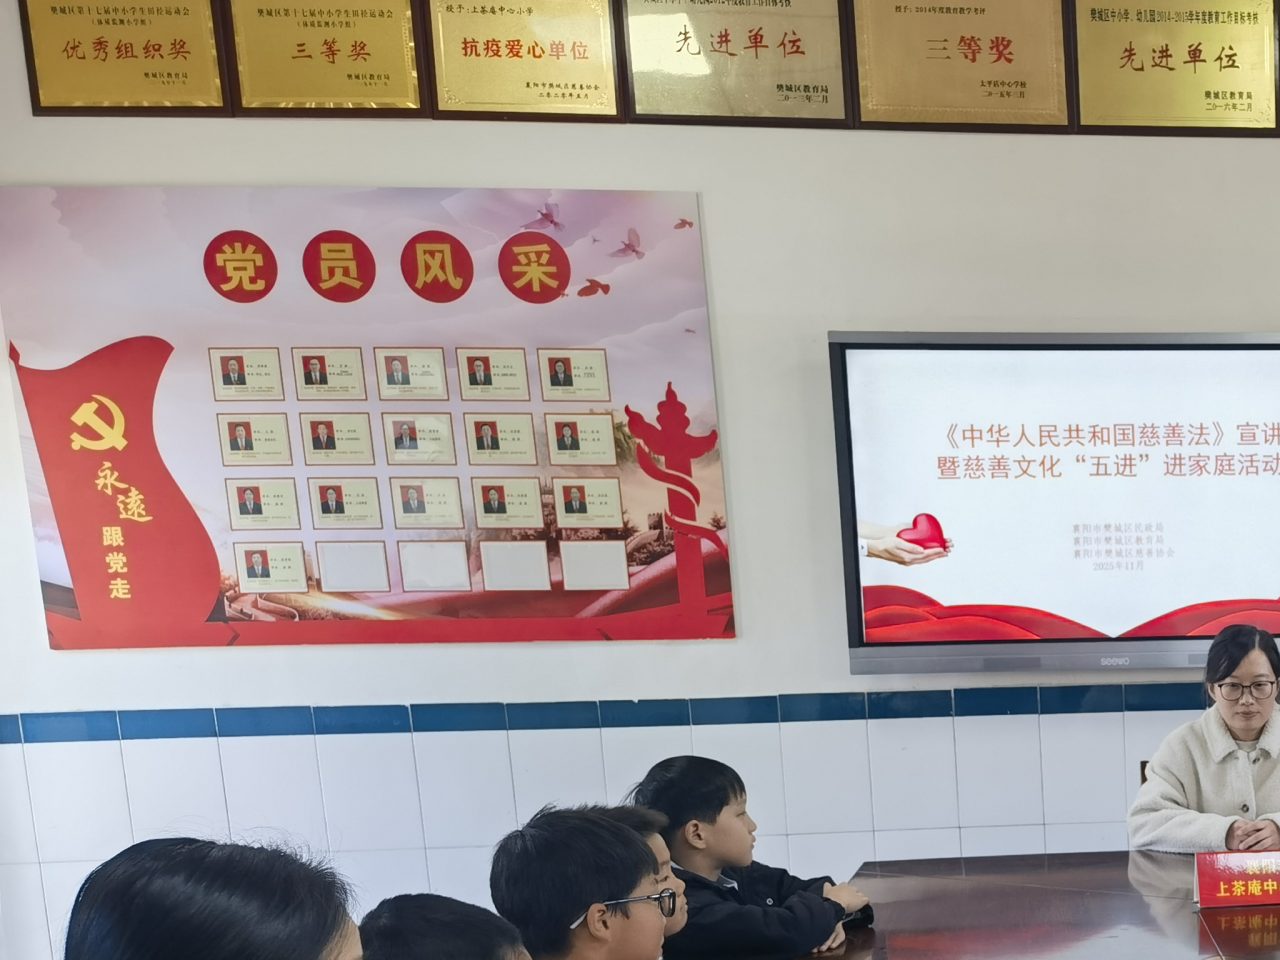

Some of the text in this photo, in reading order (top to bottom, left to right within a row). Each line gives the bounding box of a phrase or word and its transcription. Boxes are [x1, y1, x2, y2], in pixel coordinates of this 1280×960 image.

[62, 36, 191, 63] 优秀组织奖
[291, 37, 371, 64] 三等奖
[461, 37, 589, 60] 抗疫爱心单位
[676, 24, 806, 59] 先进单位
[925, 35, 1015, 64] 三等奖
[1120, 41, 1240, 74] 先进单位
[1204, 90, 1253, 100] 樊城区教育局
[215, 241, 560, 293] 党员风采
